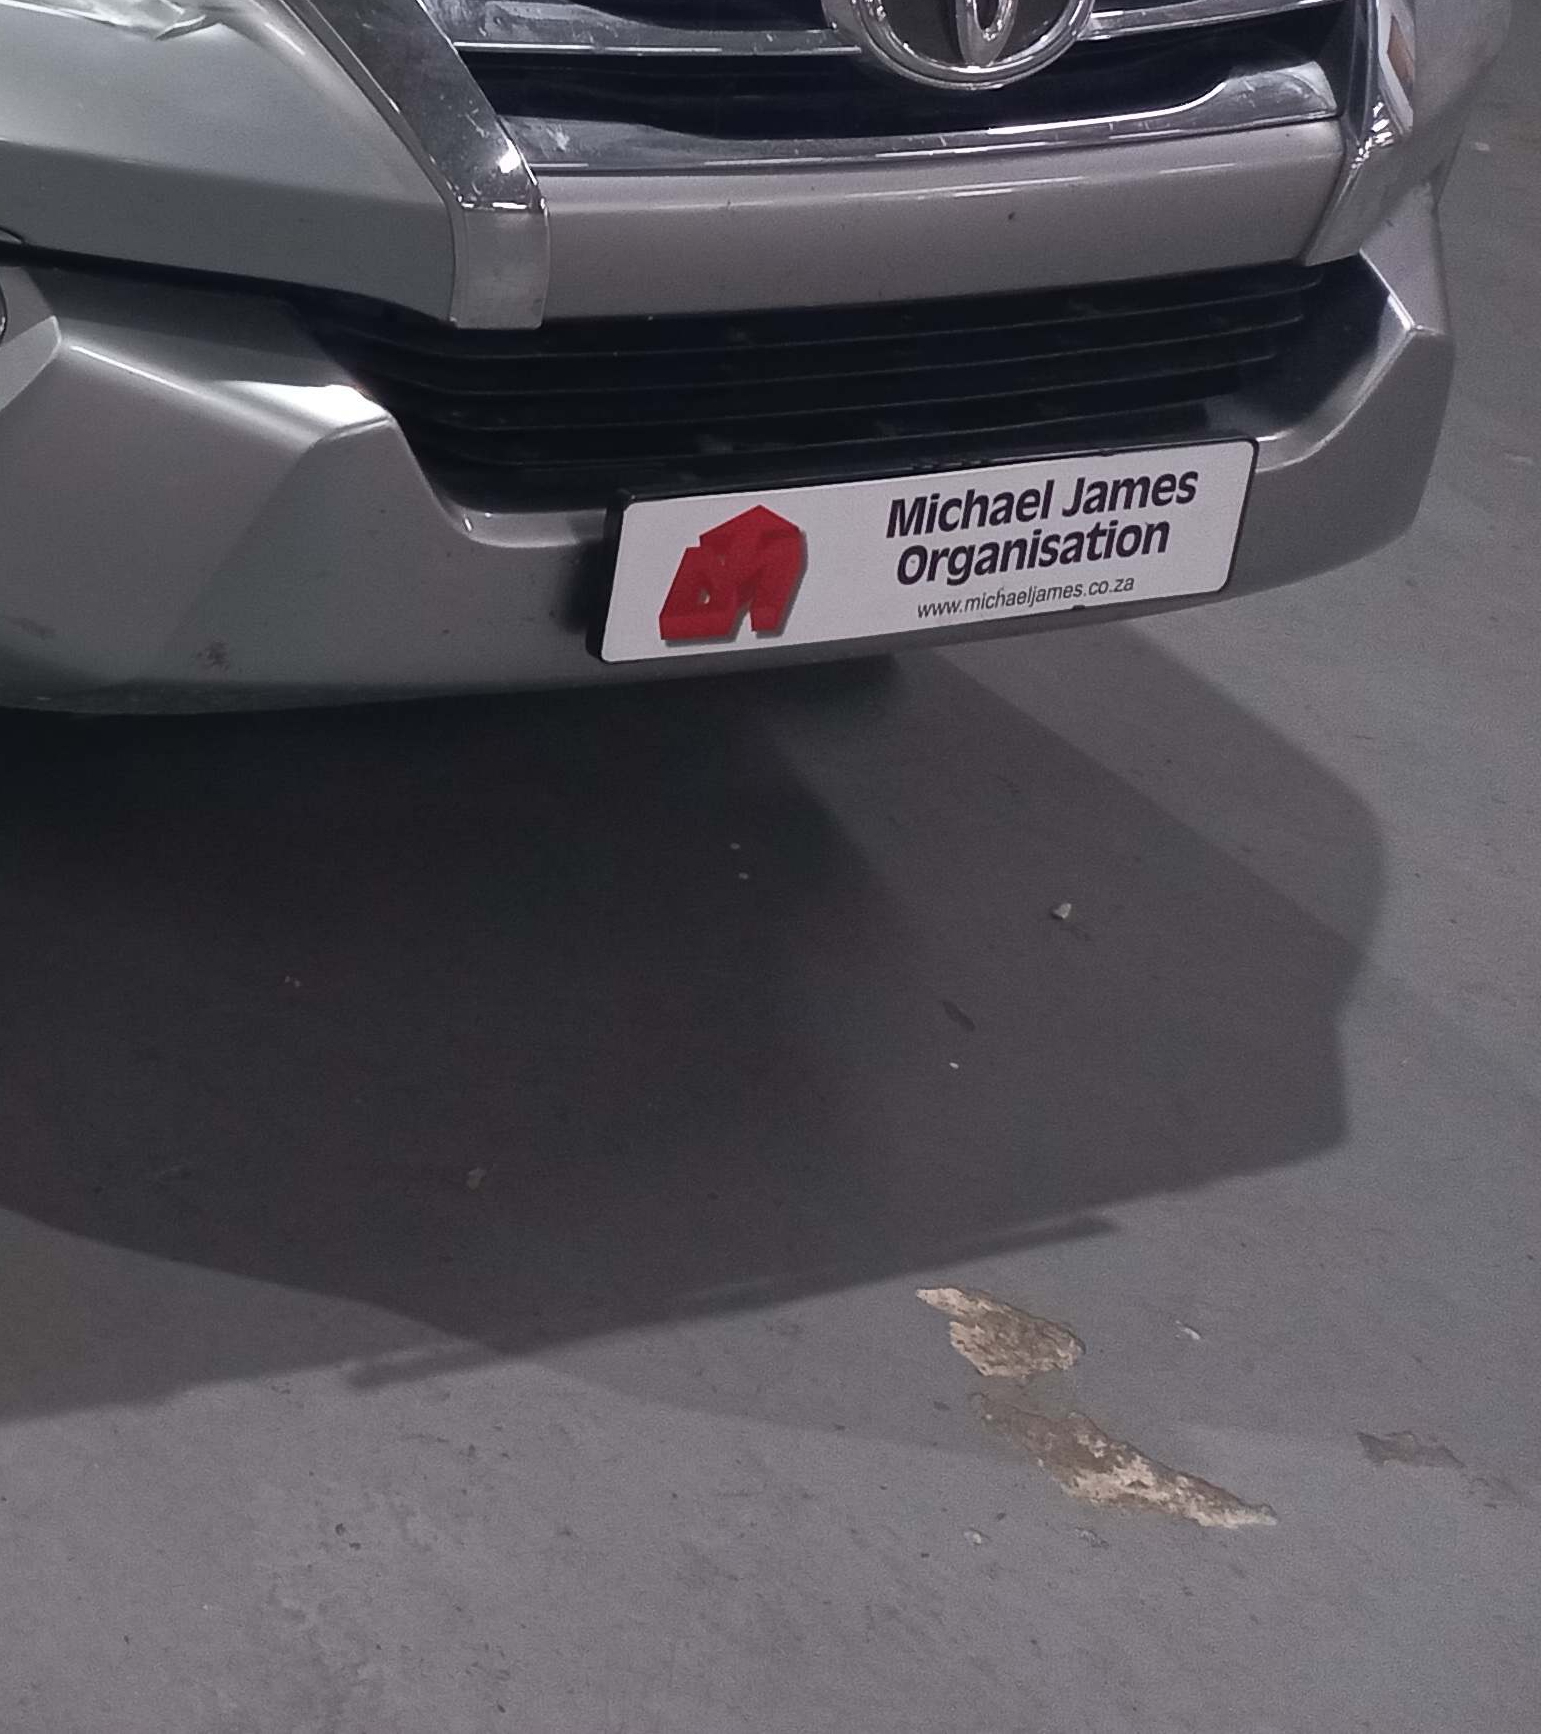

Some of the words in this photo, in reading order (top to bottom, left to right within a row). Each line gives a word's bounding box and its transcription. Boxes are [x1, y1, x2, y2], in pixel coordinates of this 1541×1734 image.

[885, 479, 1055, 539] Michael
[1062, 470, 1198, 516] James
[897, 520, 1170, 586] Organisation
[917, 576, 1134, 619] www.michaeljames.co.za
